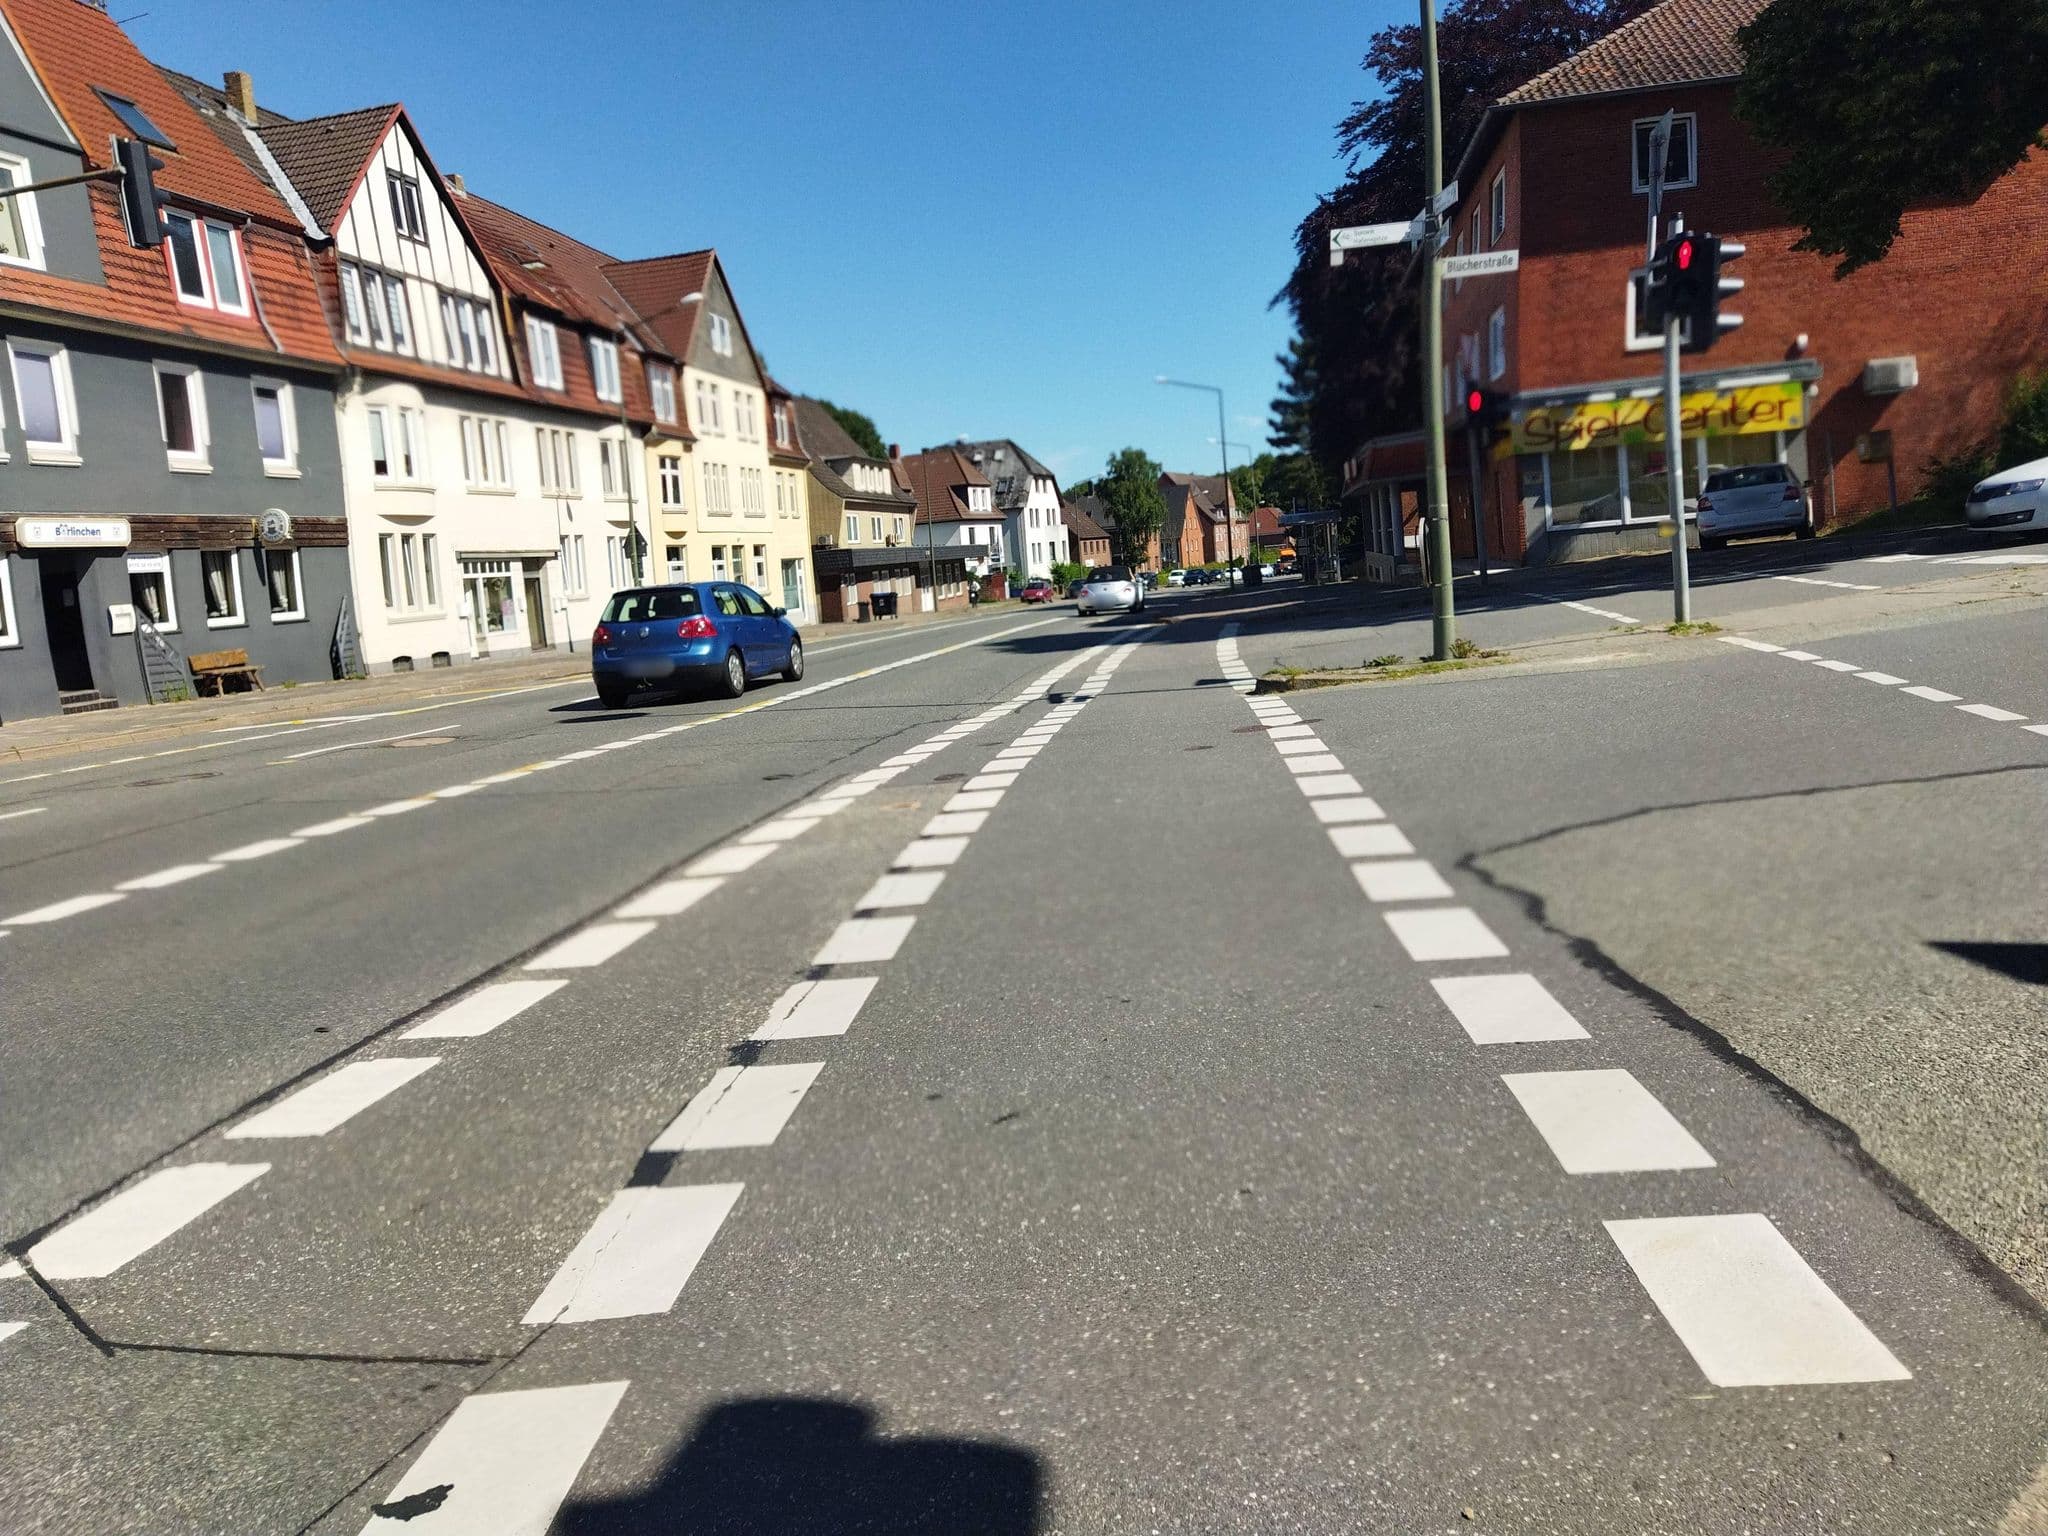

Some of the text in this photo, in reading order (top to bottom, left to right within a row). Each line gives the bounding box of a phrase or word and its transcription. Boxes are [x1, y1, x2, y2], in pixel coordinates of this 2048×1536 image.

[1447, 254, 1514, 273] Blücherstraße
[1524, 392, 1794, 451] Spiel Center
